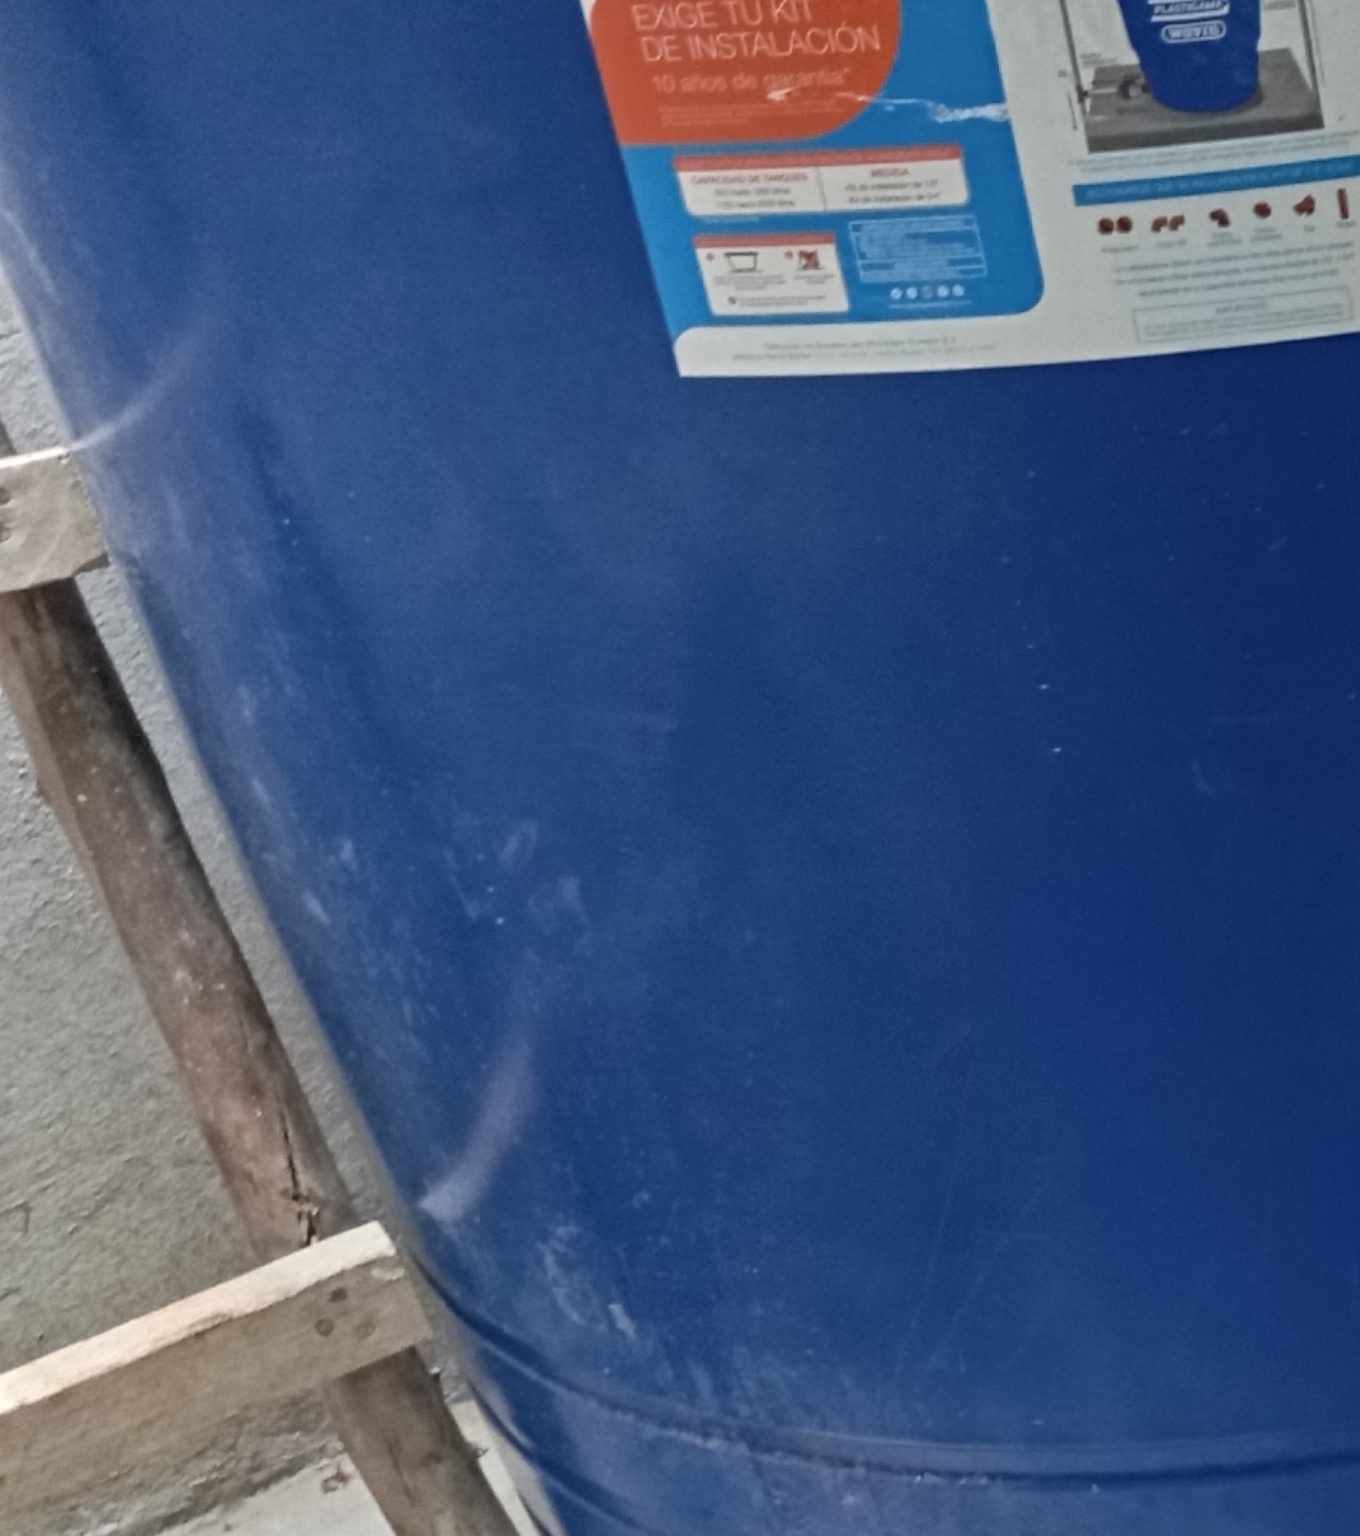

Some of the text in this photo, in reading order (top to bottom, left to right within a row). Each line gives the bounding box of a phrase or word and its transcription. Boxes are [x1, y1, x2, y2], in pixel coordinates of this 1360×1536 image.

[631, 0, 814, 31] EXIGE TU KIT
[640, 21, 882, 62] DE INSTALACIÓN
[652, 75, 676, 94] 10
[680, 73, 728, 93] años
[732, 71, 758, 90] de
